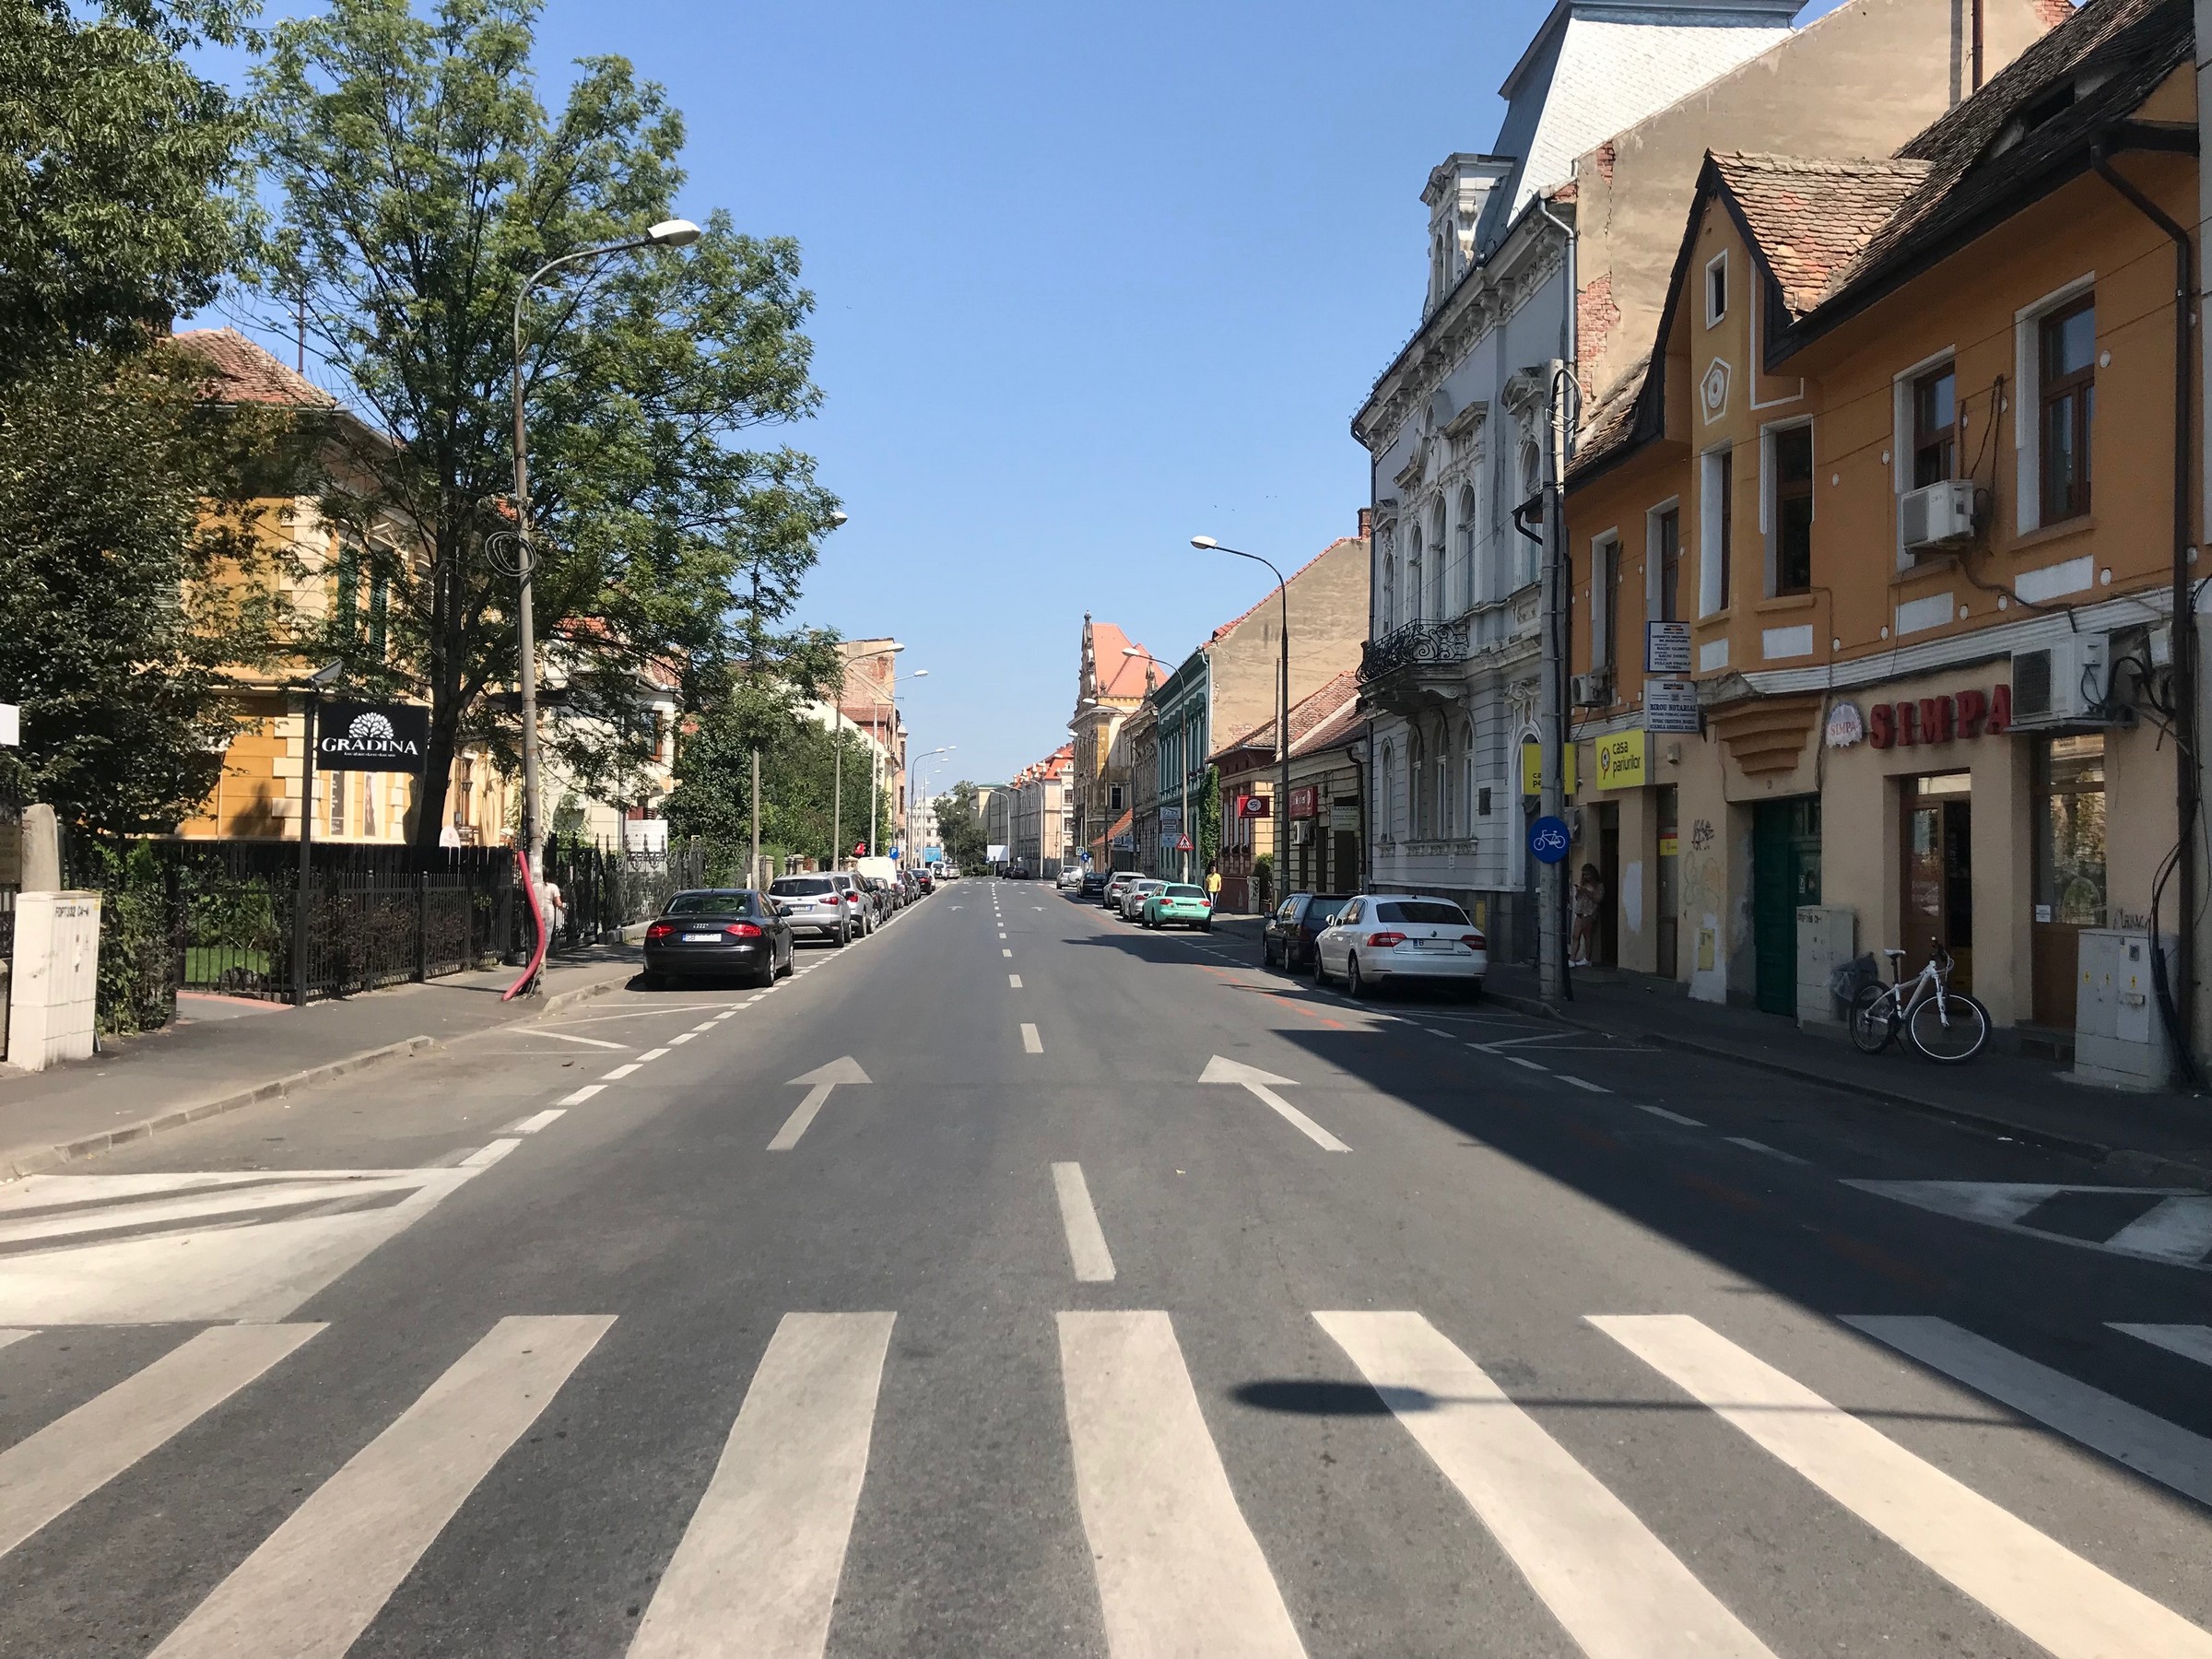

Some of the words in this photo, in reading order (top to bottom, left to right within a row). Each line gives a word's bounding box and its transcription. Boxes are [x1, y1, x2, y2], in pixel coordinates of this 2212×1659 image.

[1870, 684, 2011, 749] SIMPA
[1830, 722, 1857, 736] SIMPA
[1612, 740, 1628, 755] casa
[1612, 755, 1641, 779] pariurilor
